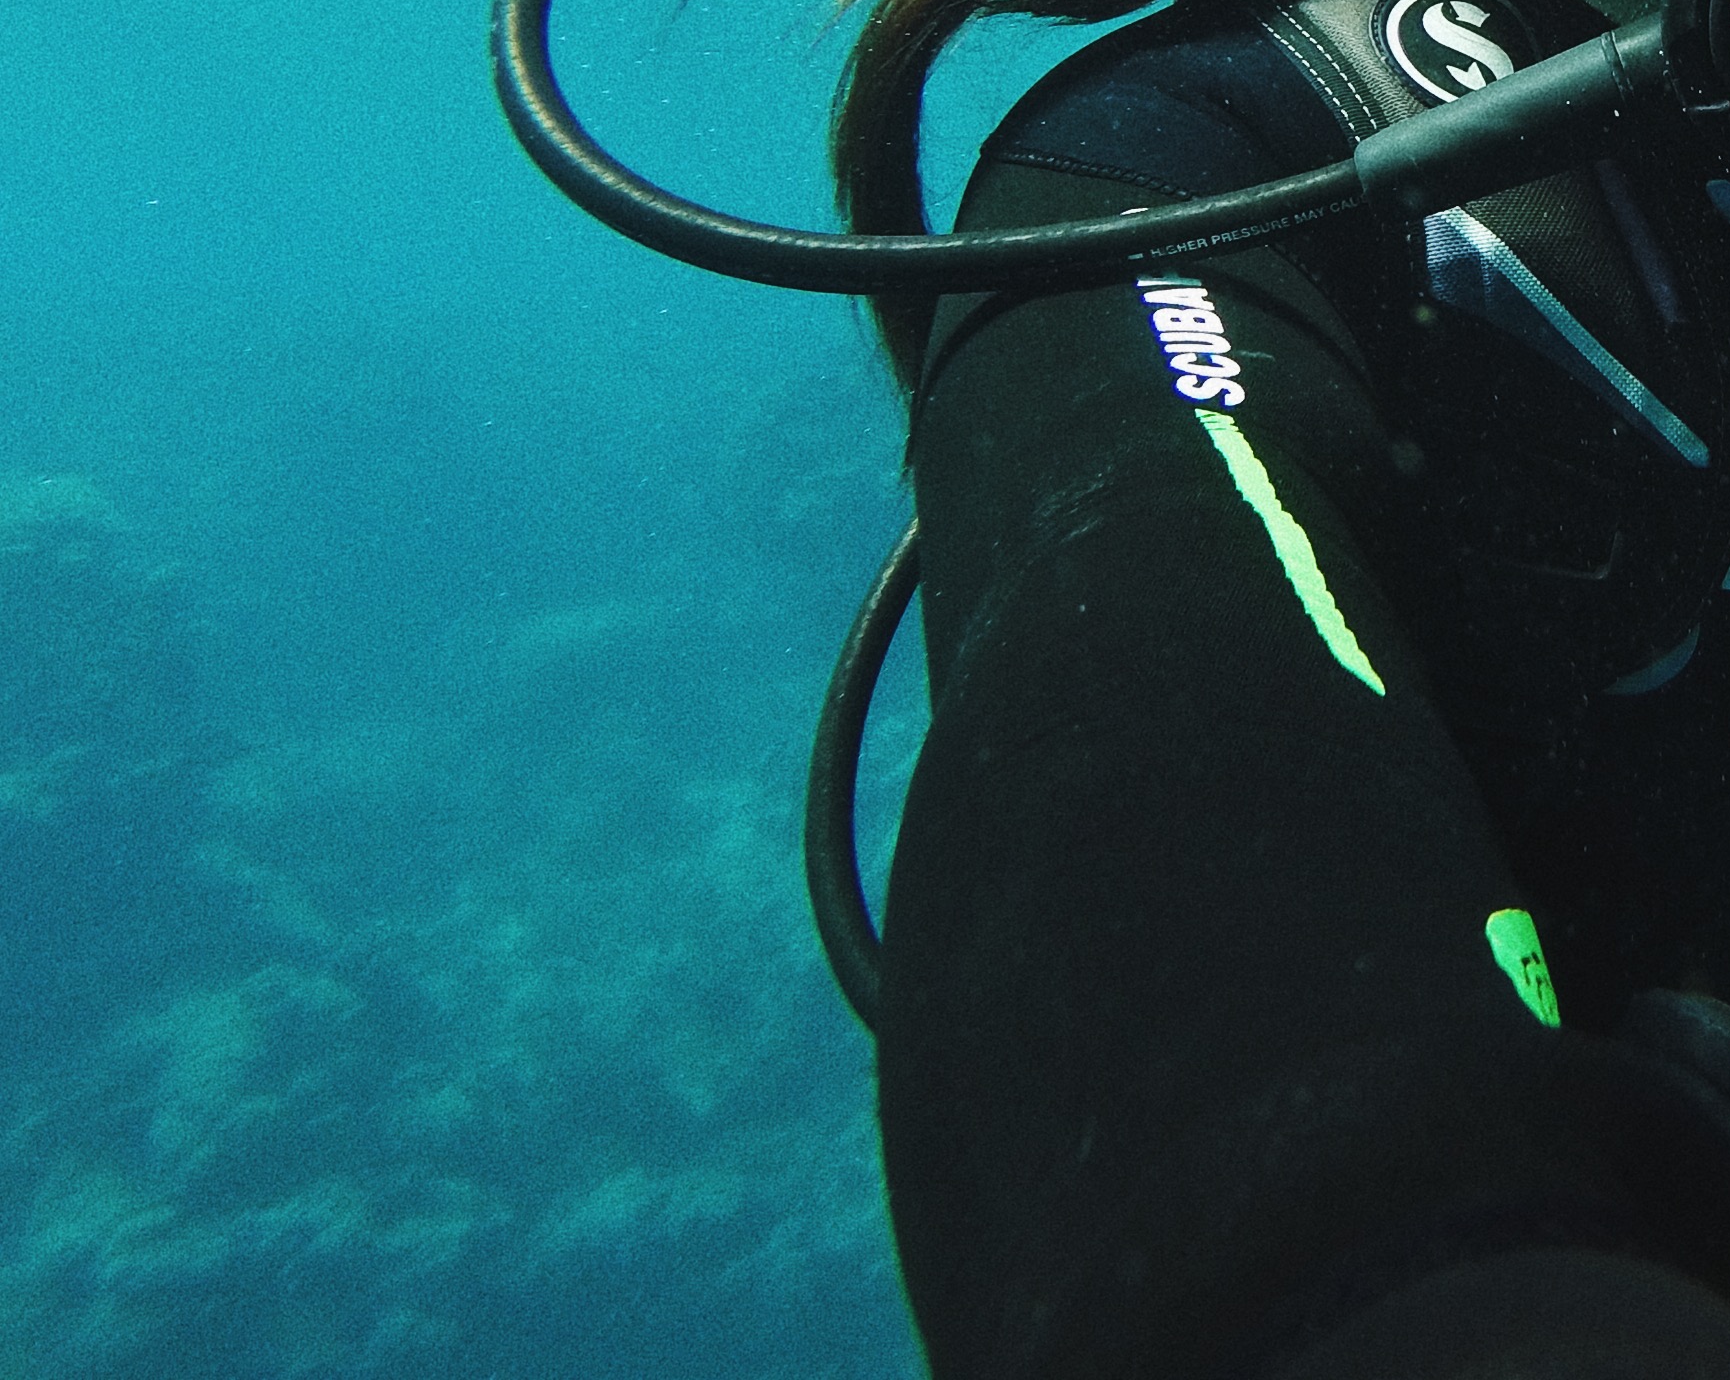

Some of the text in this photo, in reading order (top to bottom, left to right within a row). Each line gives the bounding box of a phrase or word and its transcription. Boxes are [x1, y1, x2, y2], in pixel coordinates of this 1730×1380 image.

[1150, 237, 1208, 259] HGHER
[1211, 217, 1289, 245] PRESSURE
[1294, 207, 1325, 225] MAY
